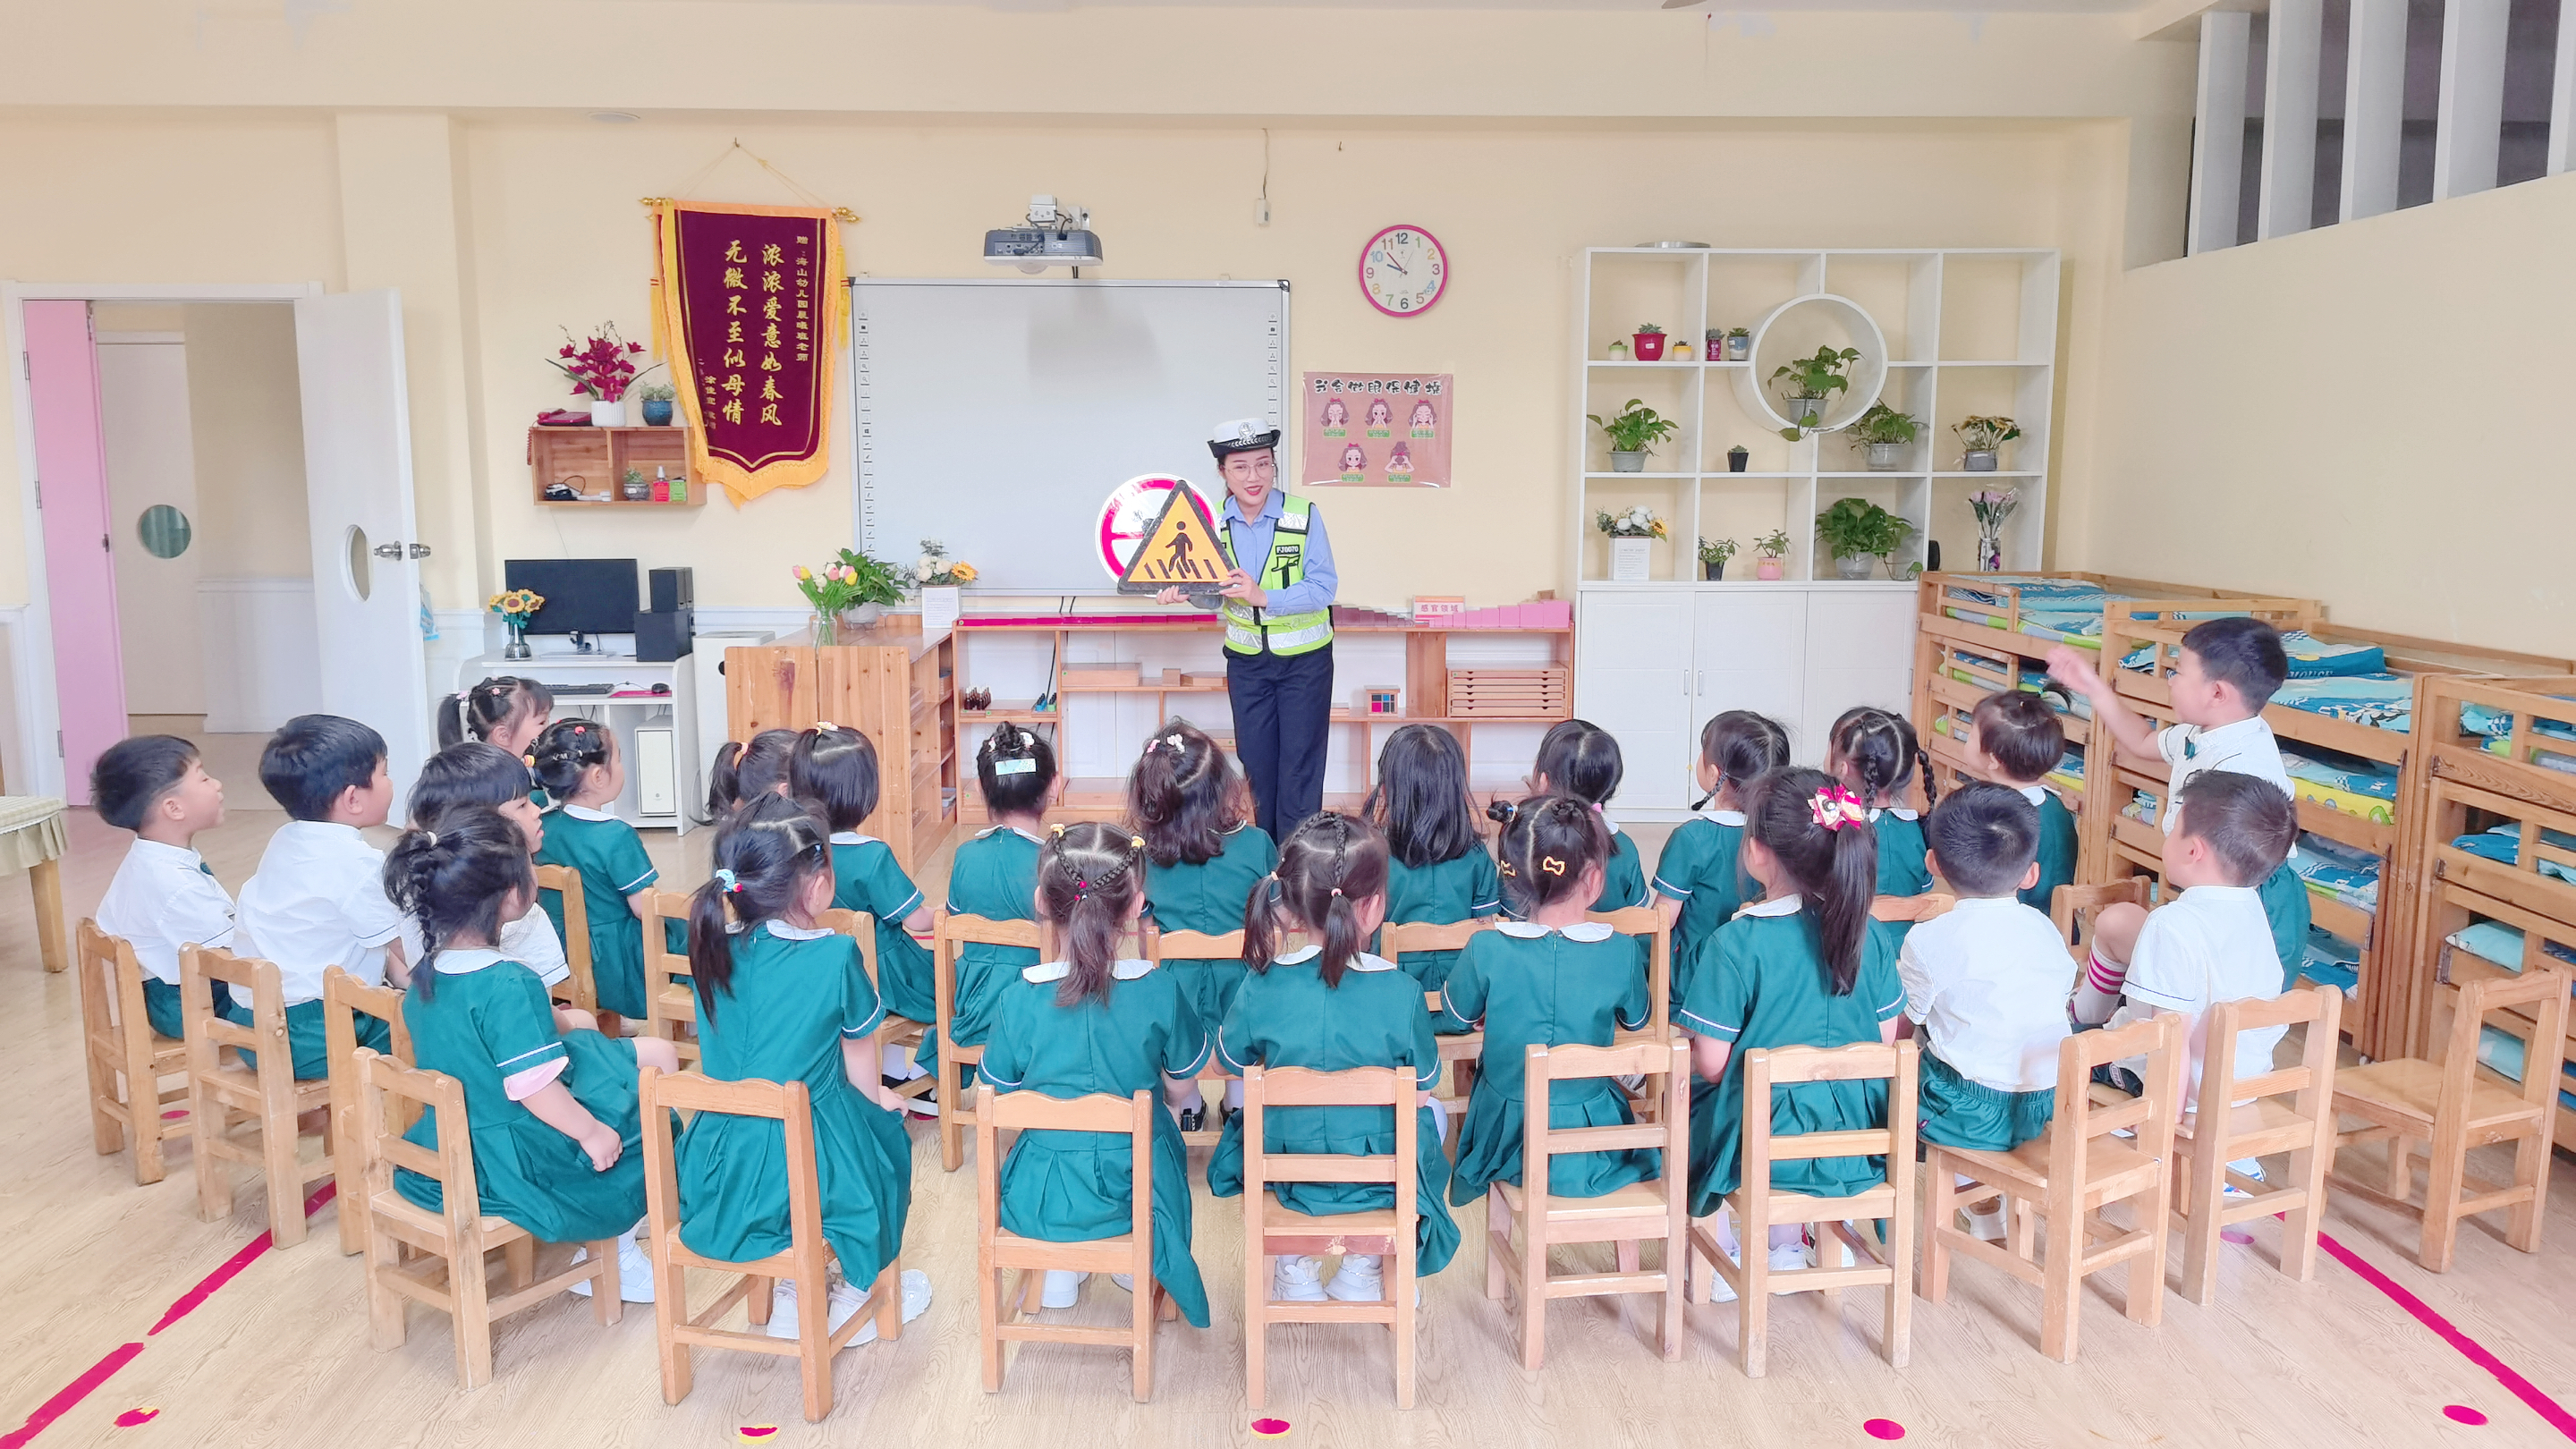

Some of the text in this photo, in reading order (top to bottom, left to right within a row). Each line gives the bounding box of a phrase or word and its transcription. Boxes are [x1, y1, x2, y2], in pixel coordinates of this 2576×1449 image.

[1381, 238, 1394, 250] 11
[1395, 233, 1409, 244] 12
[1415, 236, 1420, 249] 1
[1370, 250, 1384, 263] 10
[1427, 248, 1436, 260] 2
[1366, 267, 1375, 279] 9
[1432, 263, 1440, 275] 3
[1372, 283, 1381, 295] 8
[1427, 280, 1436, 292] 4
[1385, 293, 1394, 306] 7
[1400, 297, 1409, 309] 6
[1416, 292, 1425, 304] 5
[721, 239, 749, 426] 无微不至似母情
[759, 243, 785, 426] 浓浓爱意如春风
[1315, 379, 1441, 394] 我会做眼保健操
[1421, 604, 1459, 613] 感官领域
